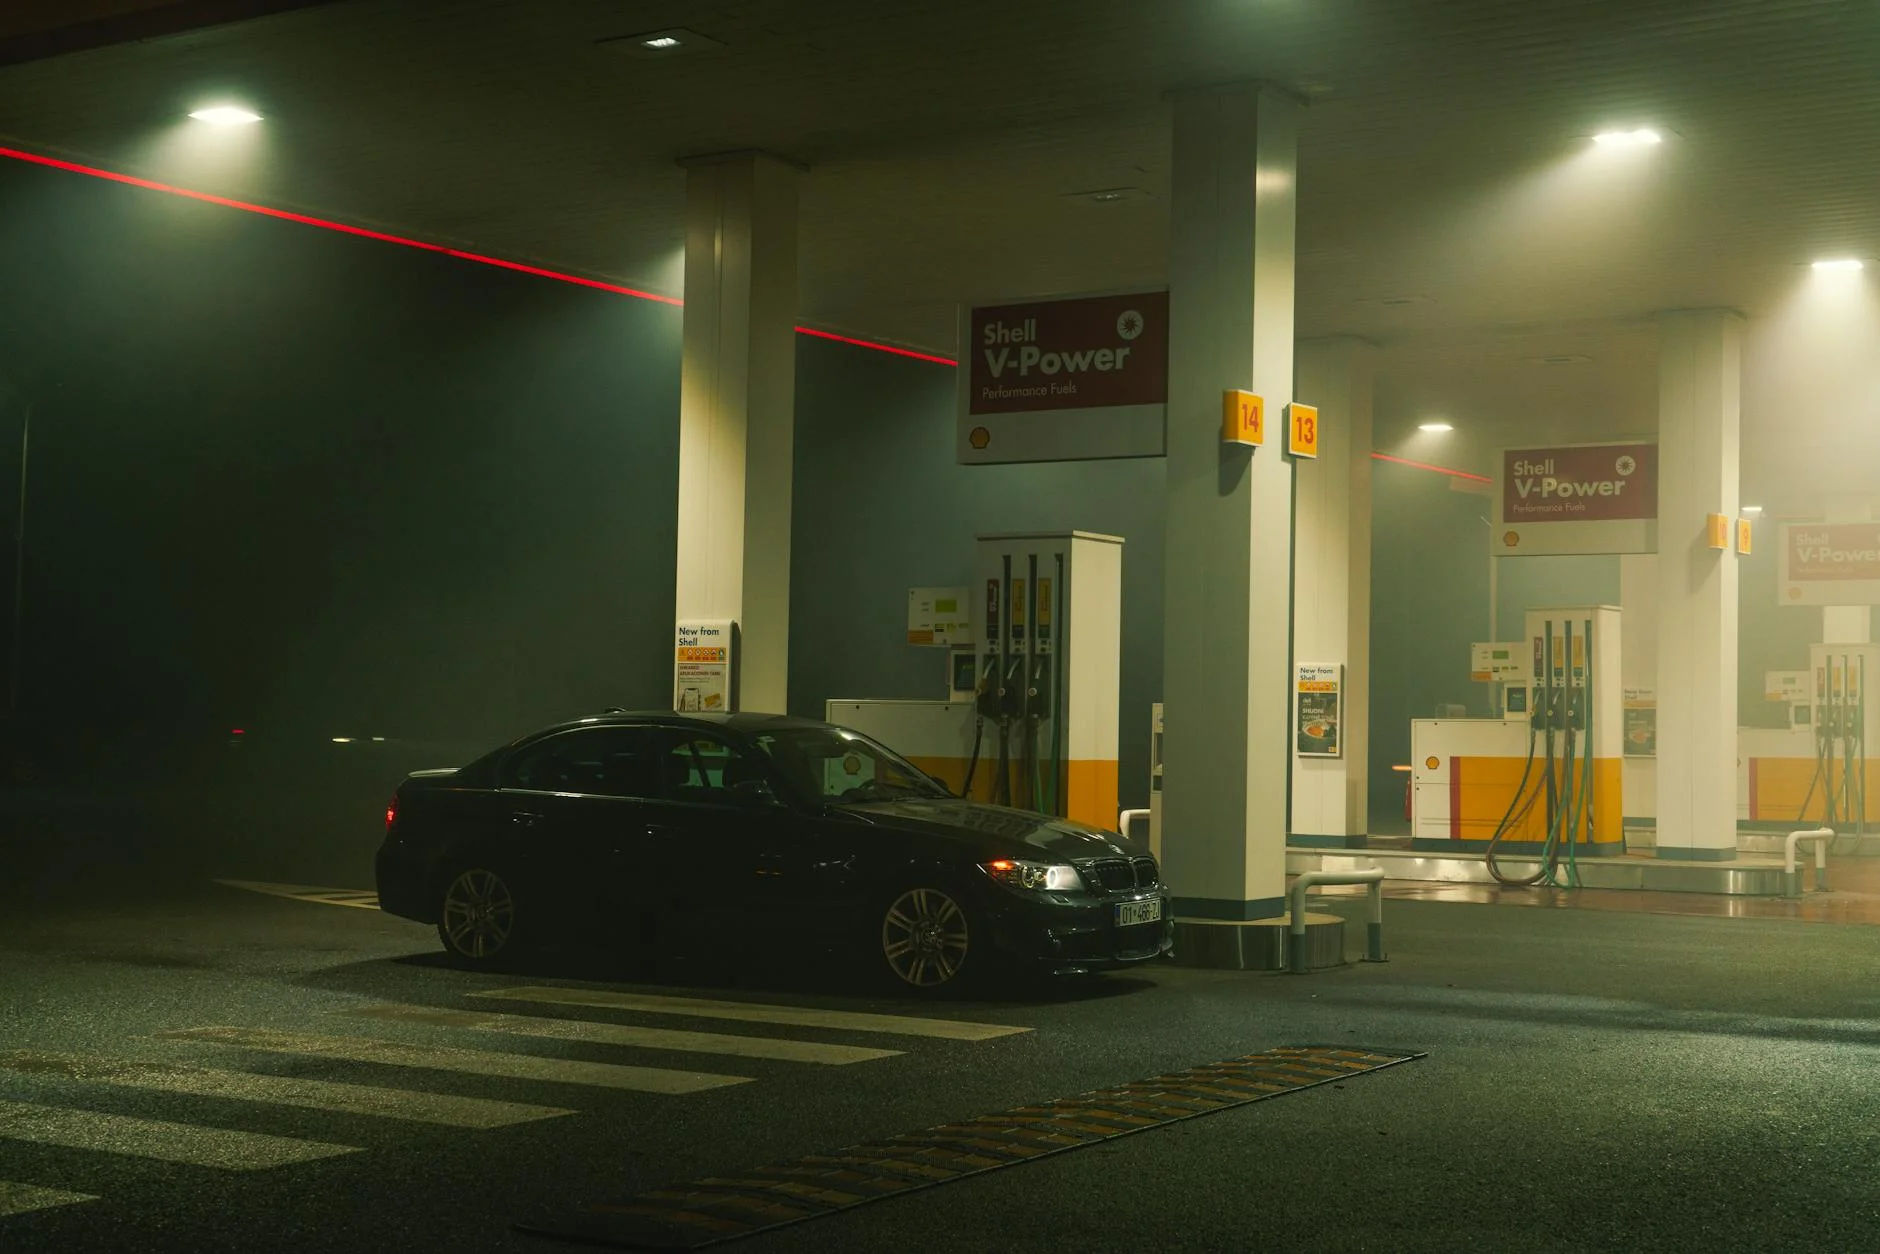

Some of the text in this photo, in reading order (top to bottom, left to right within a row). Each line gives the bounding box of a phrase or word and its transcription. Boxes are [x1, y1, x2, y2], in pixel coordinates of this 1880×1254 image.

[984, 318, 1037, 345] Shell
[984, 346, 1130, 378] V-Power
[982, 380, 1077, 400] Performance Fuels
[1242, 403, 1260, 433] 14
[1296, 416, 1314, 444] 13
[1513, 458, 1555, 477] Shell
[1514, 477, 1626, 499] V-Power
[1512, 500, 1586, 514] Performance Fuels
[1796, 532, 1829, 546] Shell
[678, 626, 720, 637] New from
[678, 638, 698, 648] Shell
[1300, 666, 1334, 675] New from
[1300, 674, 1316, 683] Shell
